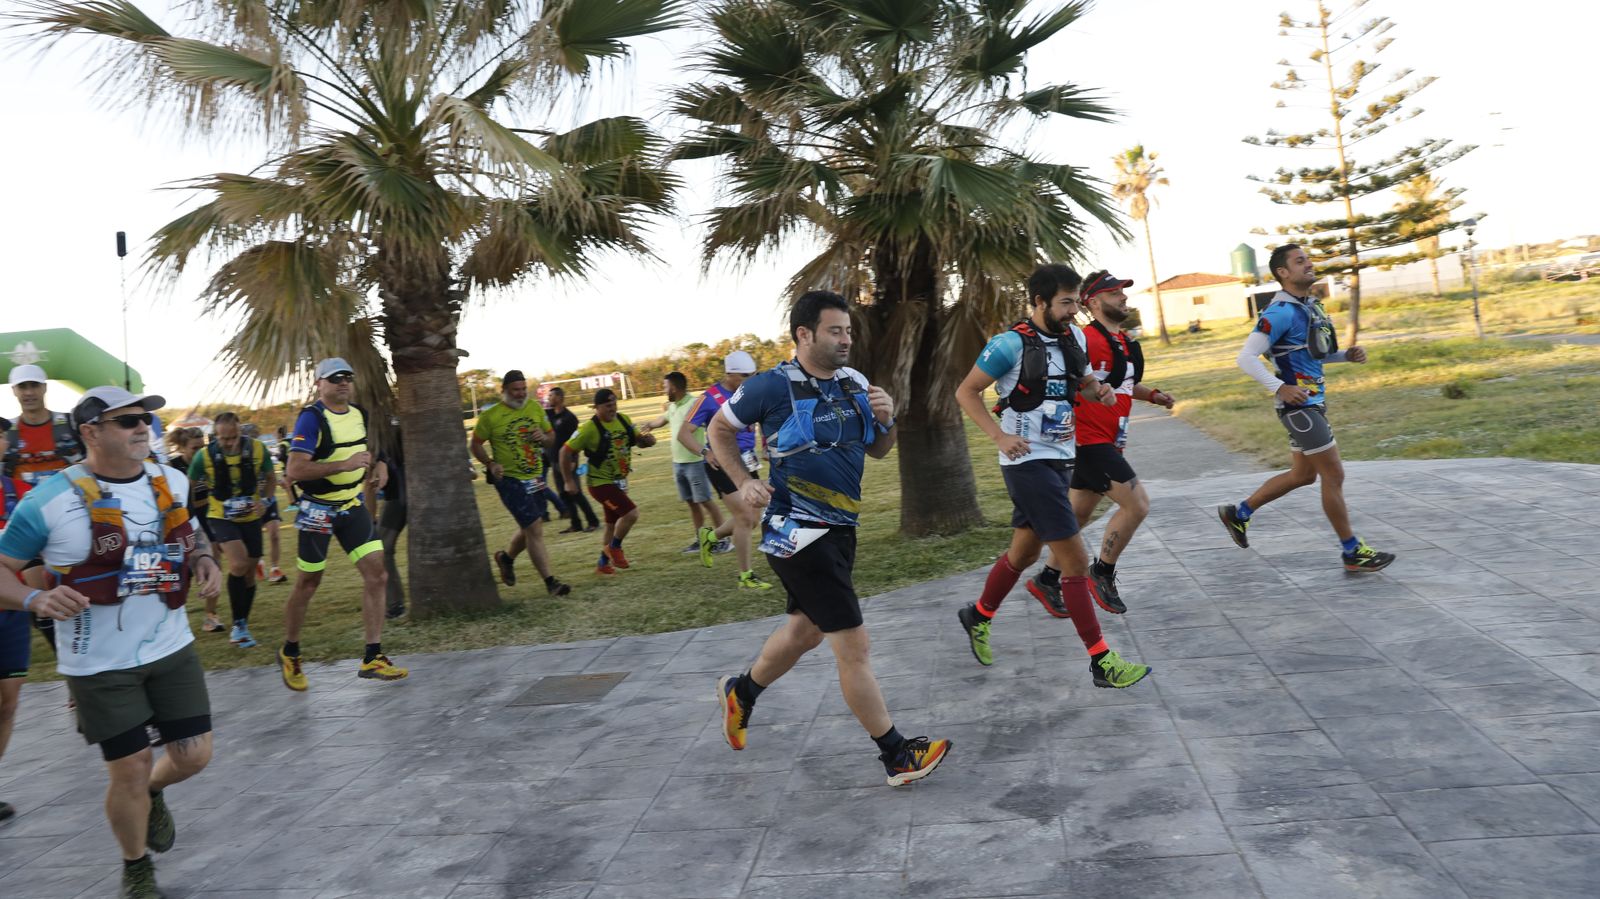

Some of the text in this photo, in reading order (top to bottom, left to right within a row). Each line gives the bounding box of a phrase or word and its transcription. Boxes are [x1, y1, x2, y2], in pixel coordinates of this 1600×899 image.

[581, 375, 614, 390] META
[133, 552, 163, 571] 192
[72, 637, 81, 655] COPA
